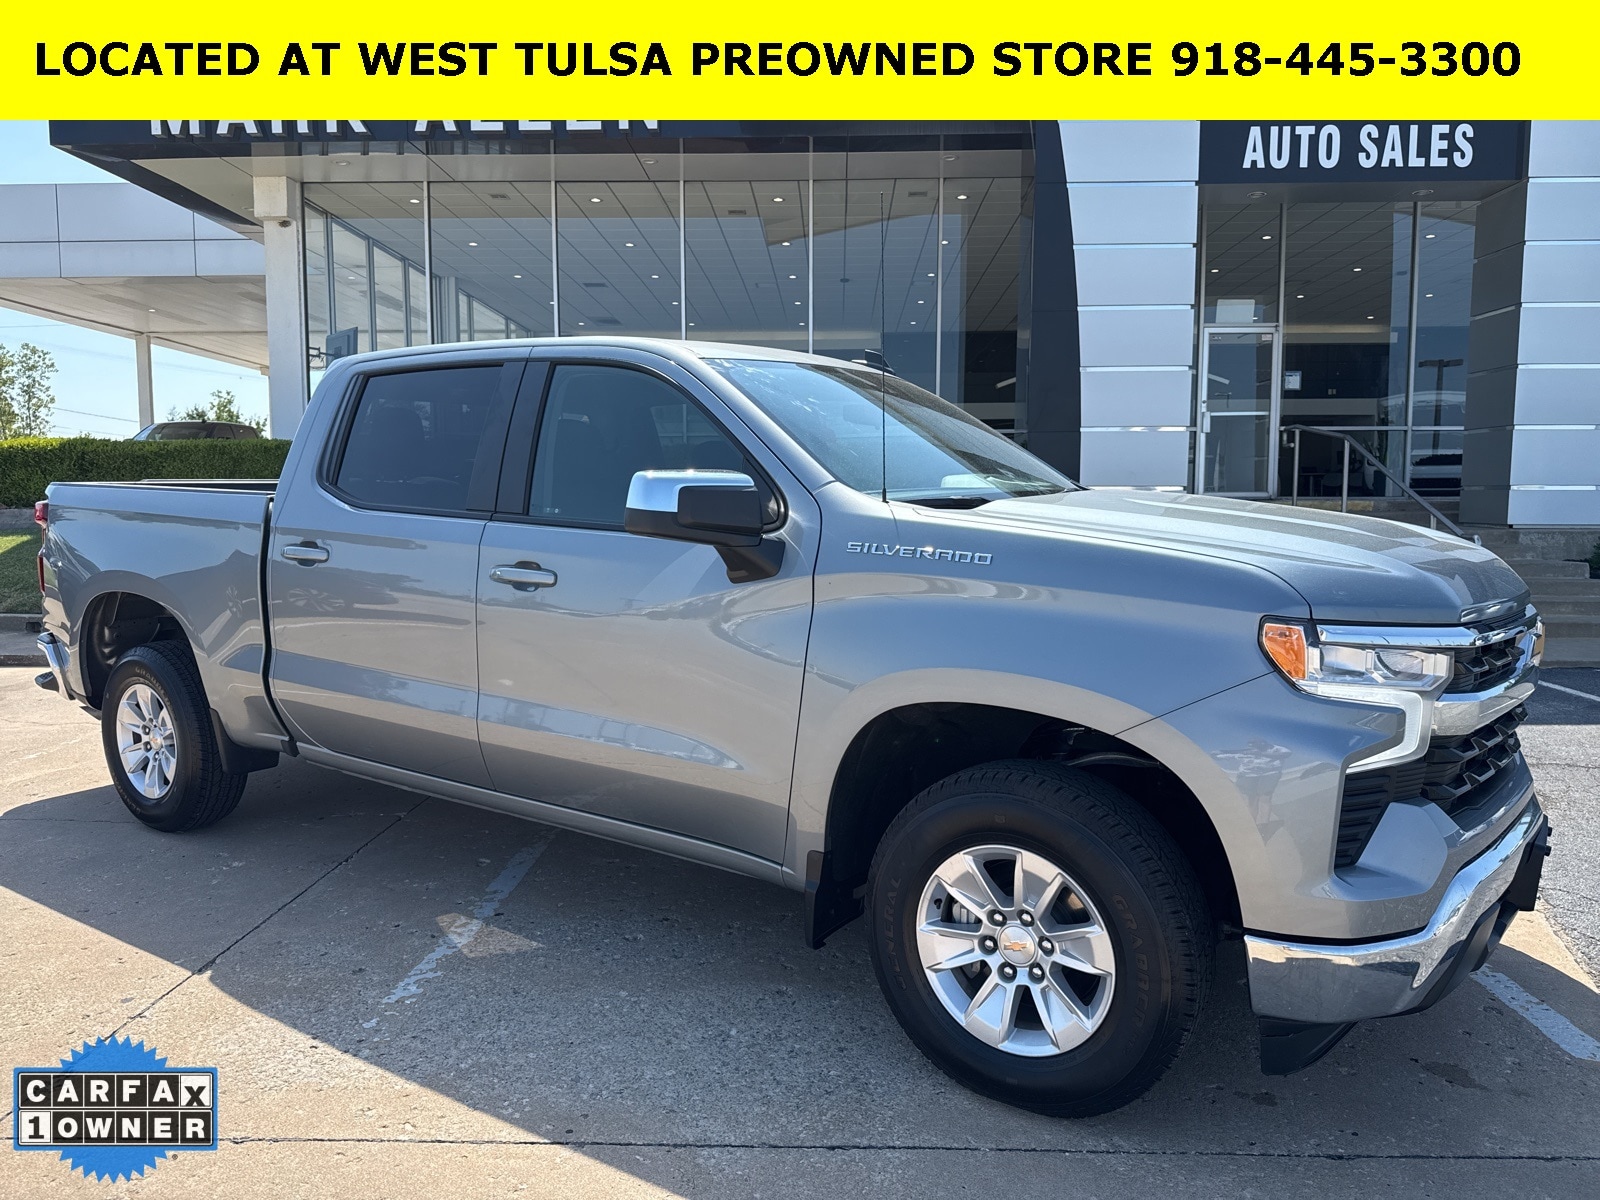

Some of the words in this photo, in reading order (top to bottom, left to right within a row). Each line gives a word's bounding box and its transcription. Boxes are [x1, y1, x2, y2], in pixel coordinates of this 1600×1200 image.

[1243, 124, 1341, 169] AUTO
[1358, 123, 1475, 168] SALES
[846, 541, 993, 565] SILVERADO
